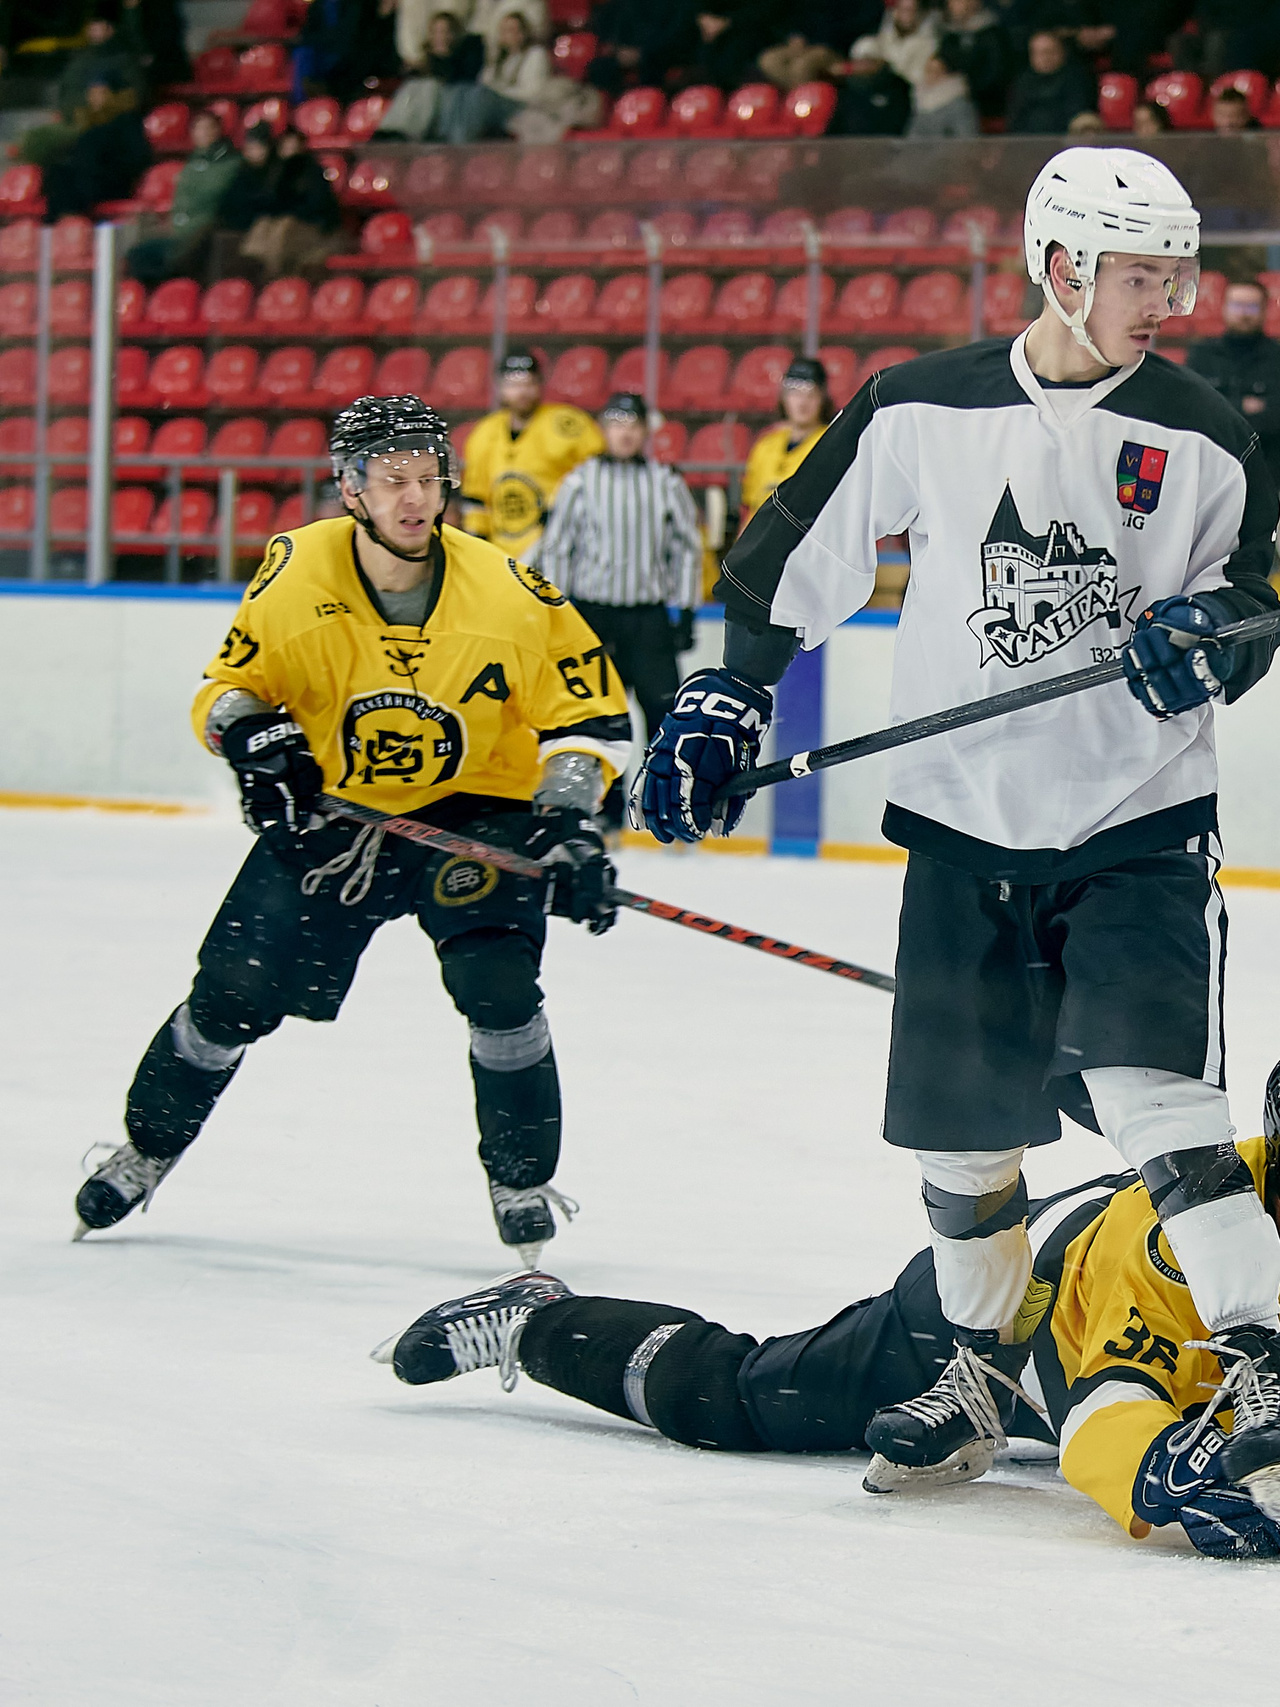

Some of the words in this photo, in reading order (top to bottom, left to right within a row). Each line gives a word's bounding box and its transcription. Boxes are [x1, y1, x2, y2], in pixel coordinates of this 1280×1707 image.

[557, 646, 609, 699] 67
[674, 690, 769, 745] CCM
[247, 721, 304, 754] BAU
[437, 740, 452, 753] 21
[1149, 1248, 1165, 1269] SPORT
[1162, 1266, 1185, 1282] REGIO
